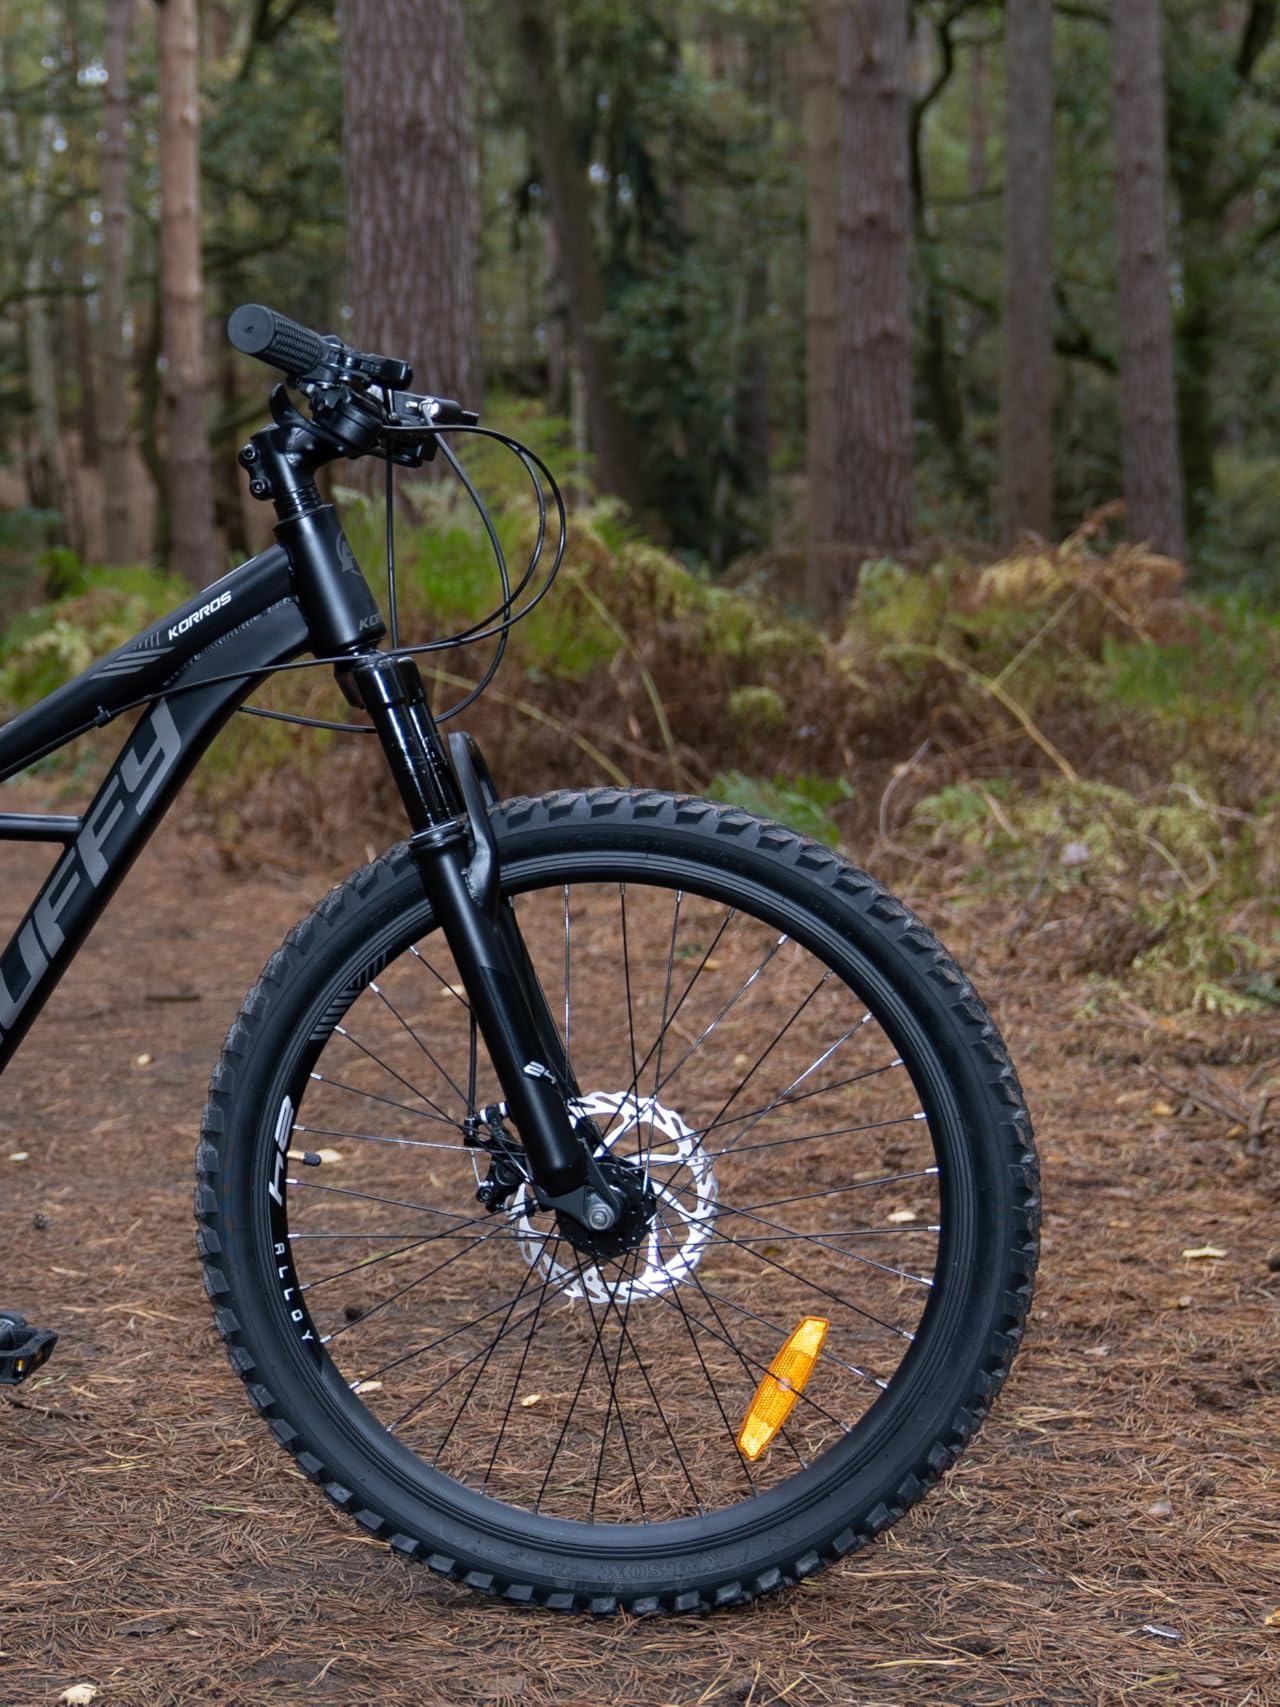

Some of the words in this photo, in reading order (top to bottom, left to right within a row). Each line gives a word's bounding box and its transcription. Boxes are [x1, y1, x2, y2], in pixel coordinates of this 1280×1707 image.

[167, 591, 231, 641] KORROS
[523, 1061, 556, 1084] 24
[269, 1095, 294, 1207] 24
[274, 1242, 314, 1340] ALLOY
